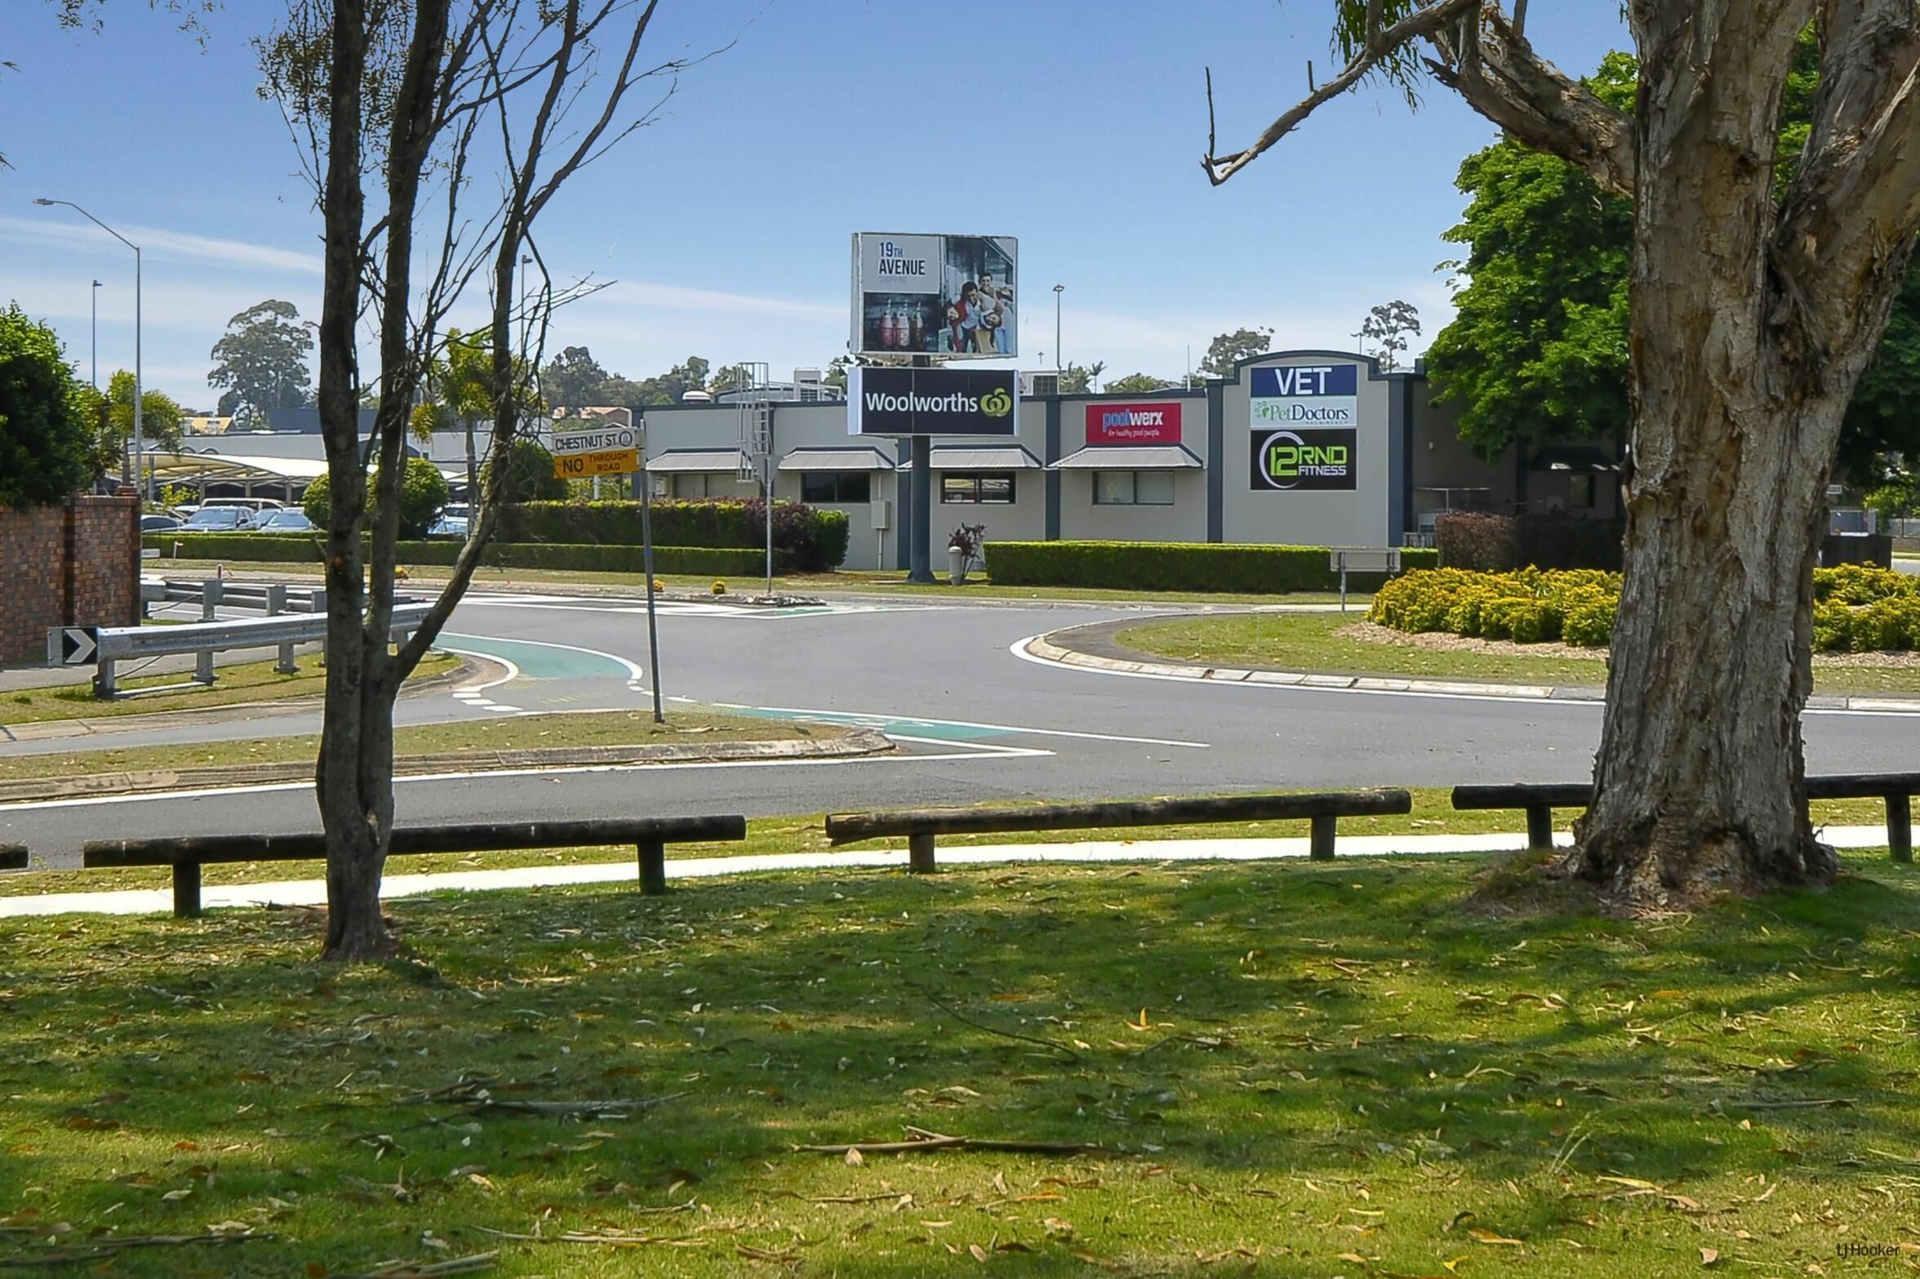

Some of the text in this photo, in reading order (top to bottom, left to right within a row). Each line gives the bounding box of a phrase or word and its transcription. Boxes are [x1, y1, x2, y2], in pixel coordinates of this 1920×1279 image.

[879, 241, 903, 258] 19TH
[879, 259, 926, 275] AVENUE
[1274, 367, 1333, 395] VET
[865, 391, 979, 413] Woolworths
[1103, 408, 1164, 433] poolwerx
[555, 434, 603, 451] CHESTNUT
[563, 458, 584, 473] NO
[589, 452, 628, 463] THROUGH
[597, 463, 621, 472] ROAD
[1299, 465, 1347, 476] FITNESS
